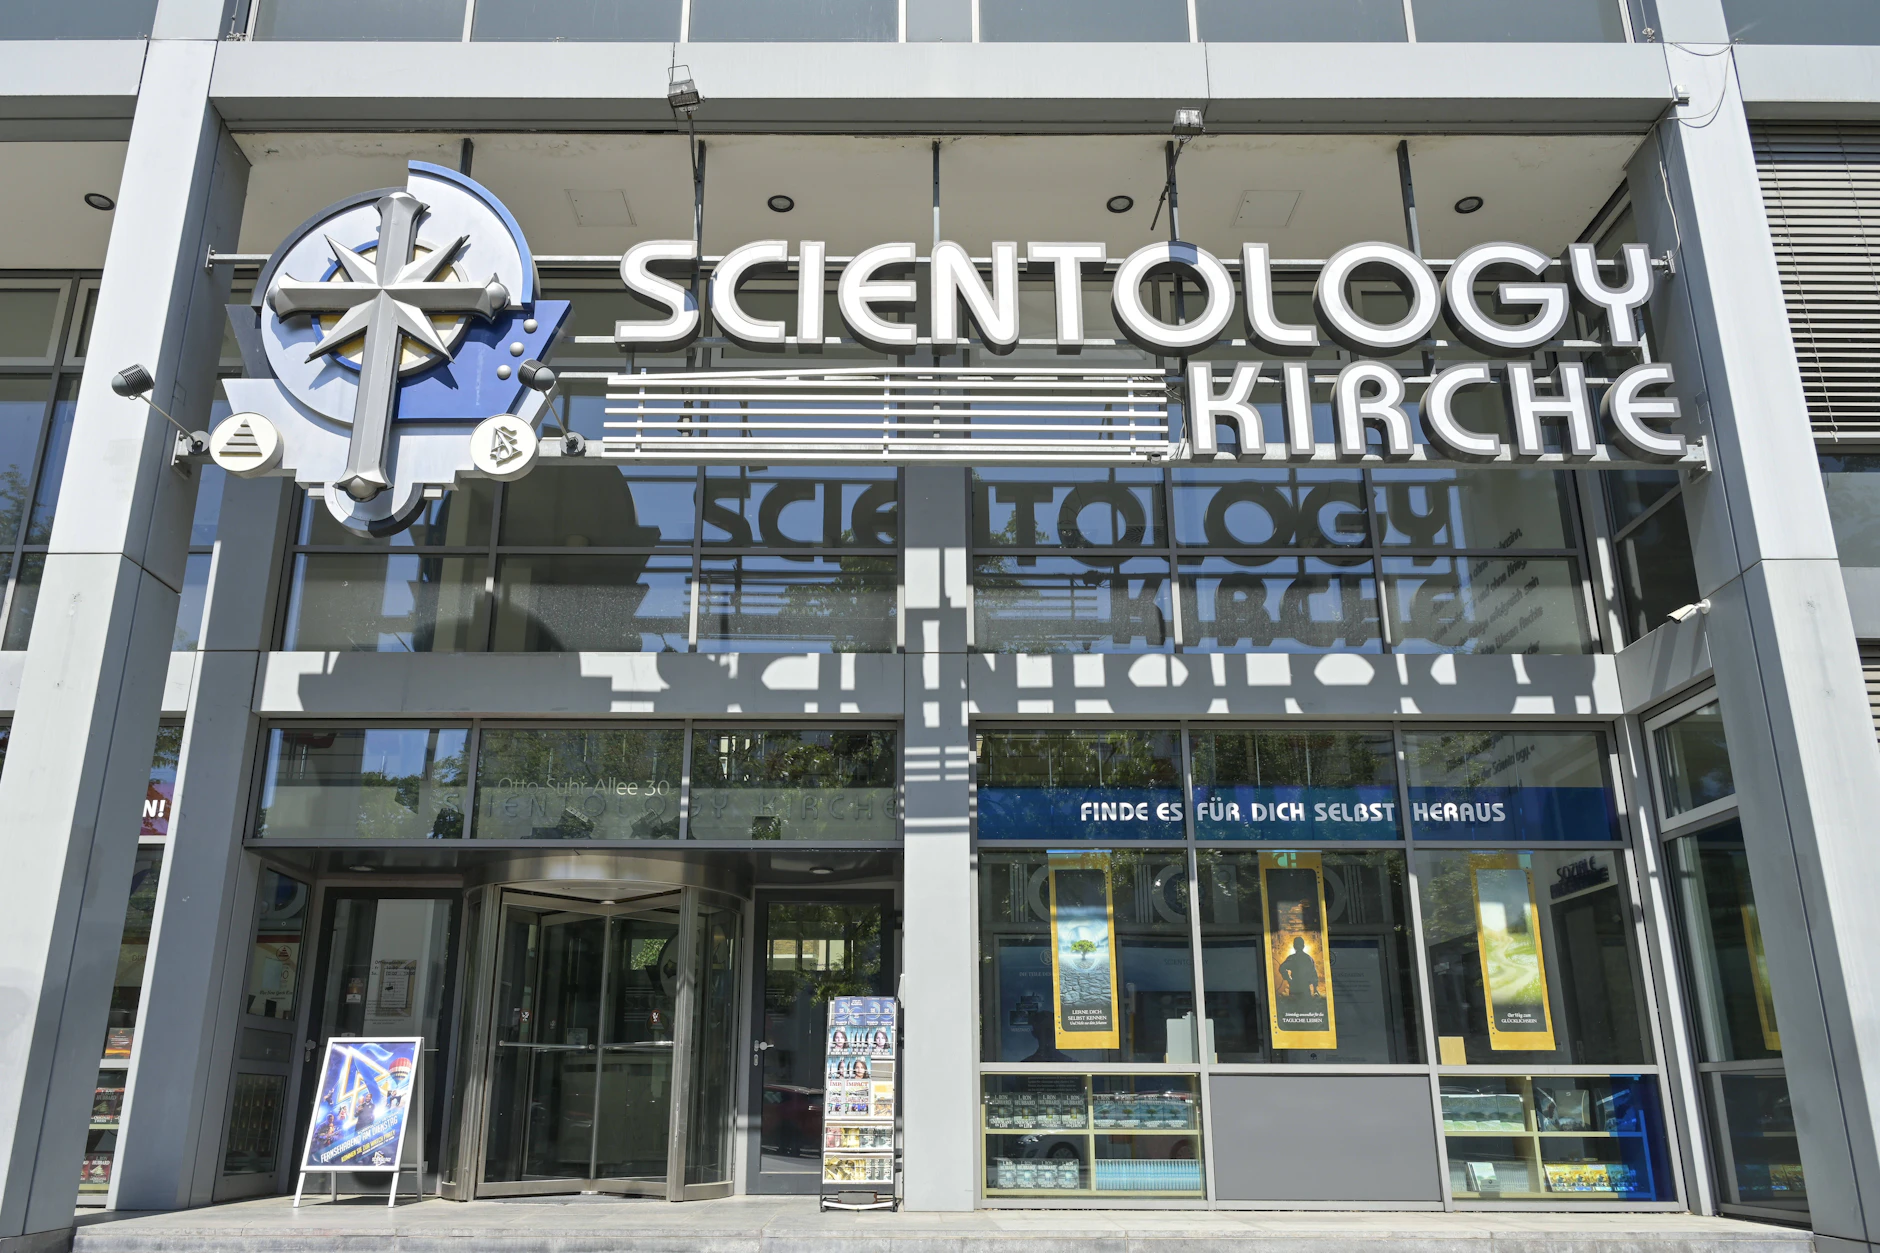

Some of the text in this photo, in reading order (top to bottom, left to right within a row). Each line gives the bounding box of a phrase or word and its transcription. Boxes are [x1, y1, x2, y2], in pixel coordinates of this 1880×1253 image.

[614, 240, 1655, 353] SCIENTOLOGY
[1187, 361, 1687, 461] KIRCHE
[644, 779, 671, 797] 30
[758, 793, 898, 821] KIRCHE
[1081, 796, 1506, 823] FINDE ES FÜR DICH SELBST HERAUS
[320, 1136, 362, 1163] FERNSEHABEND
[372, 1115, 398, 1136] DIENSTAG
